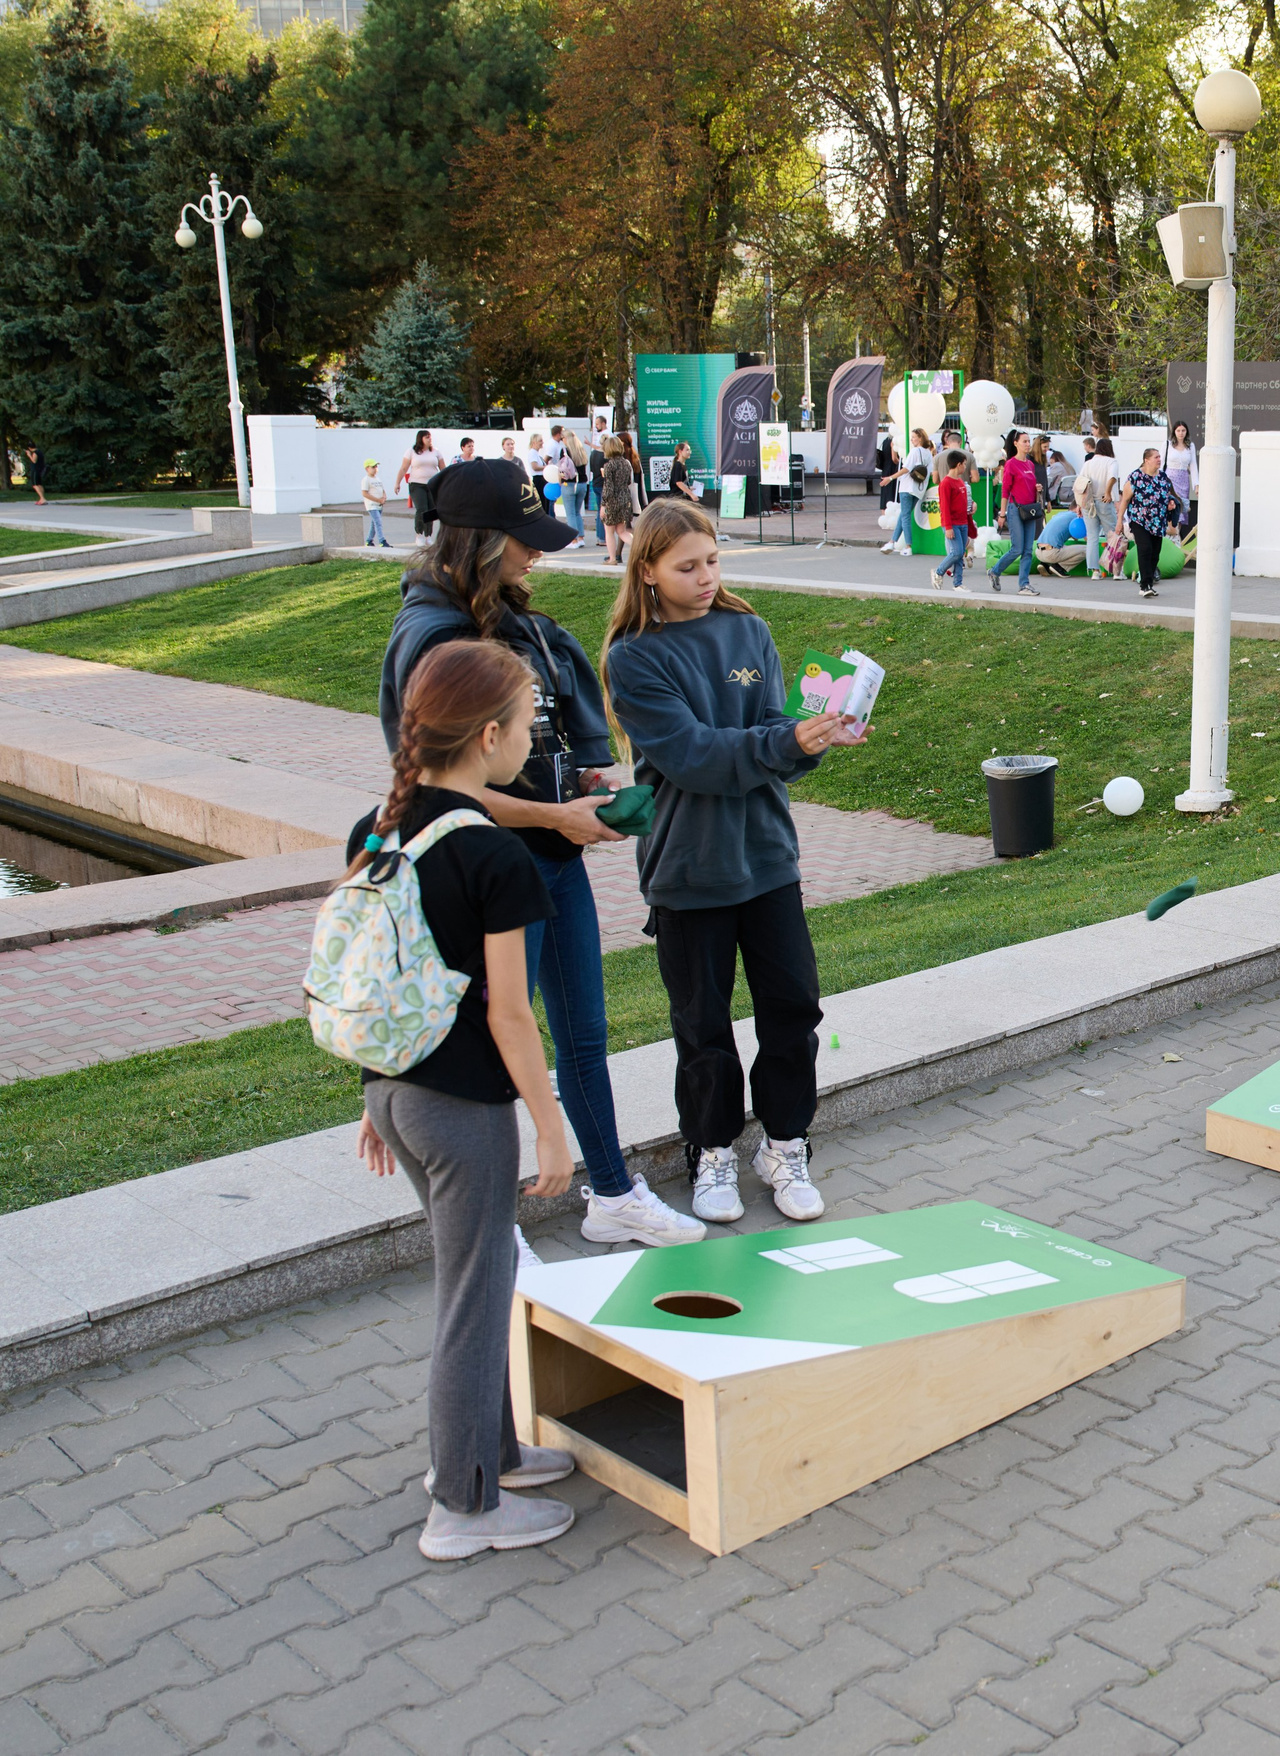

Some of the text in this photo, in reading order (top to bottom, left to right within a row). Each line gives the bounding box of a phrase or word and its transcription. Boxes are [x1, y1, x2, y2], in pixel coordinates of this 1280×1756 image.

[1235, 381, 1268, 391] партнер
[842, 426, 864, 436] АСИ
[733, 432, 756, 441] АСИ
[1054, 1245, 1093, 1260] СБЕР
